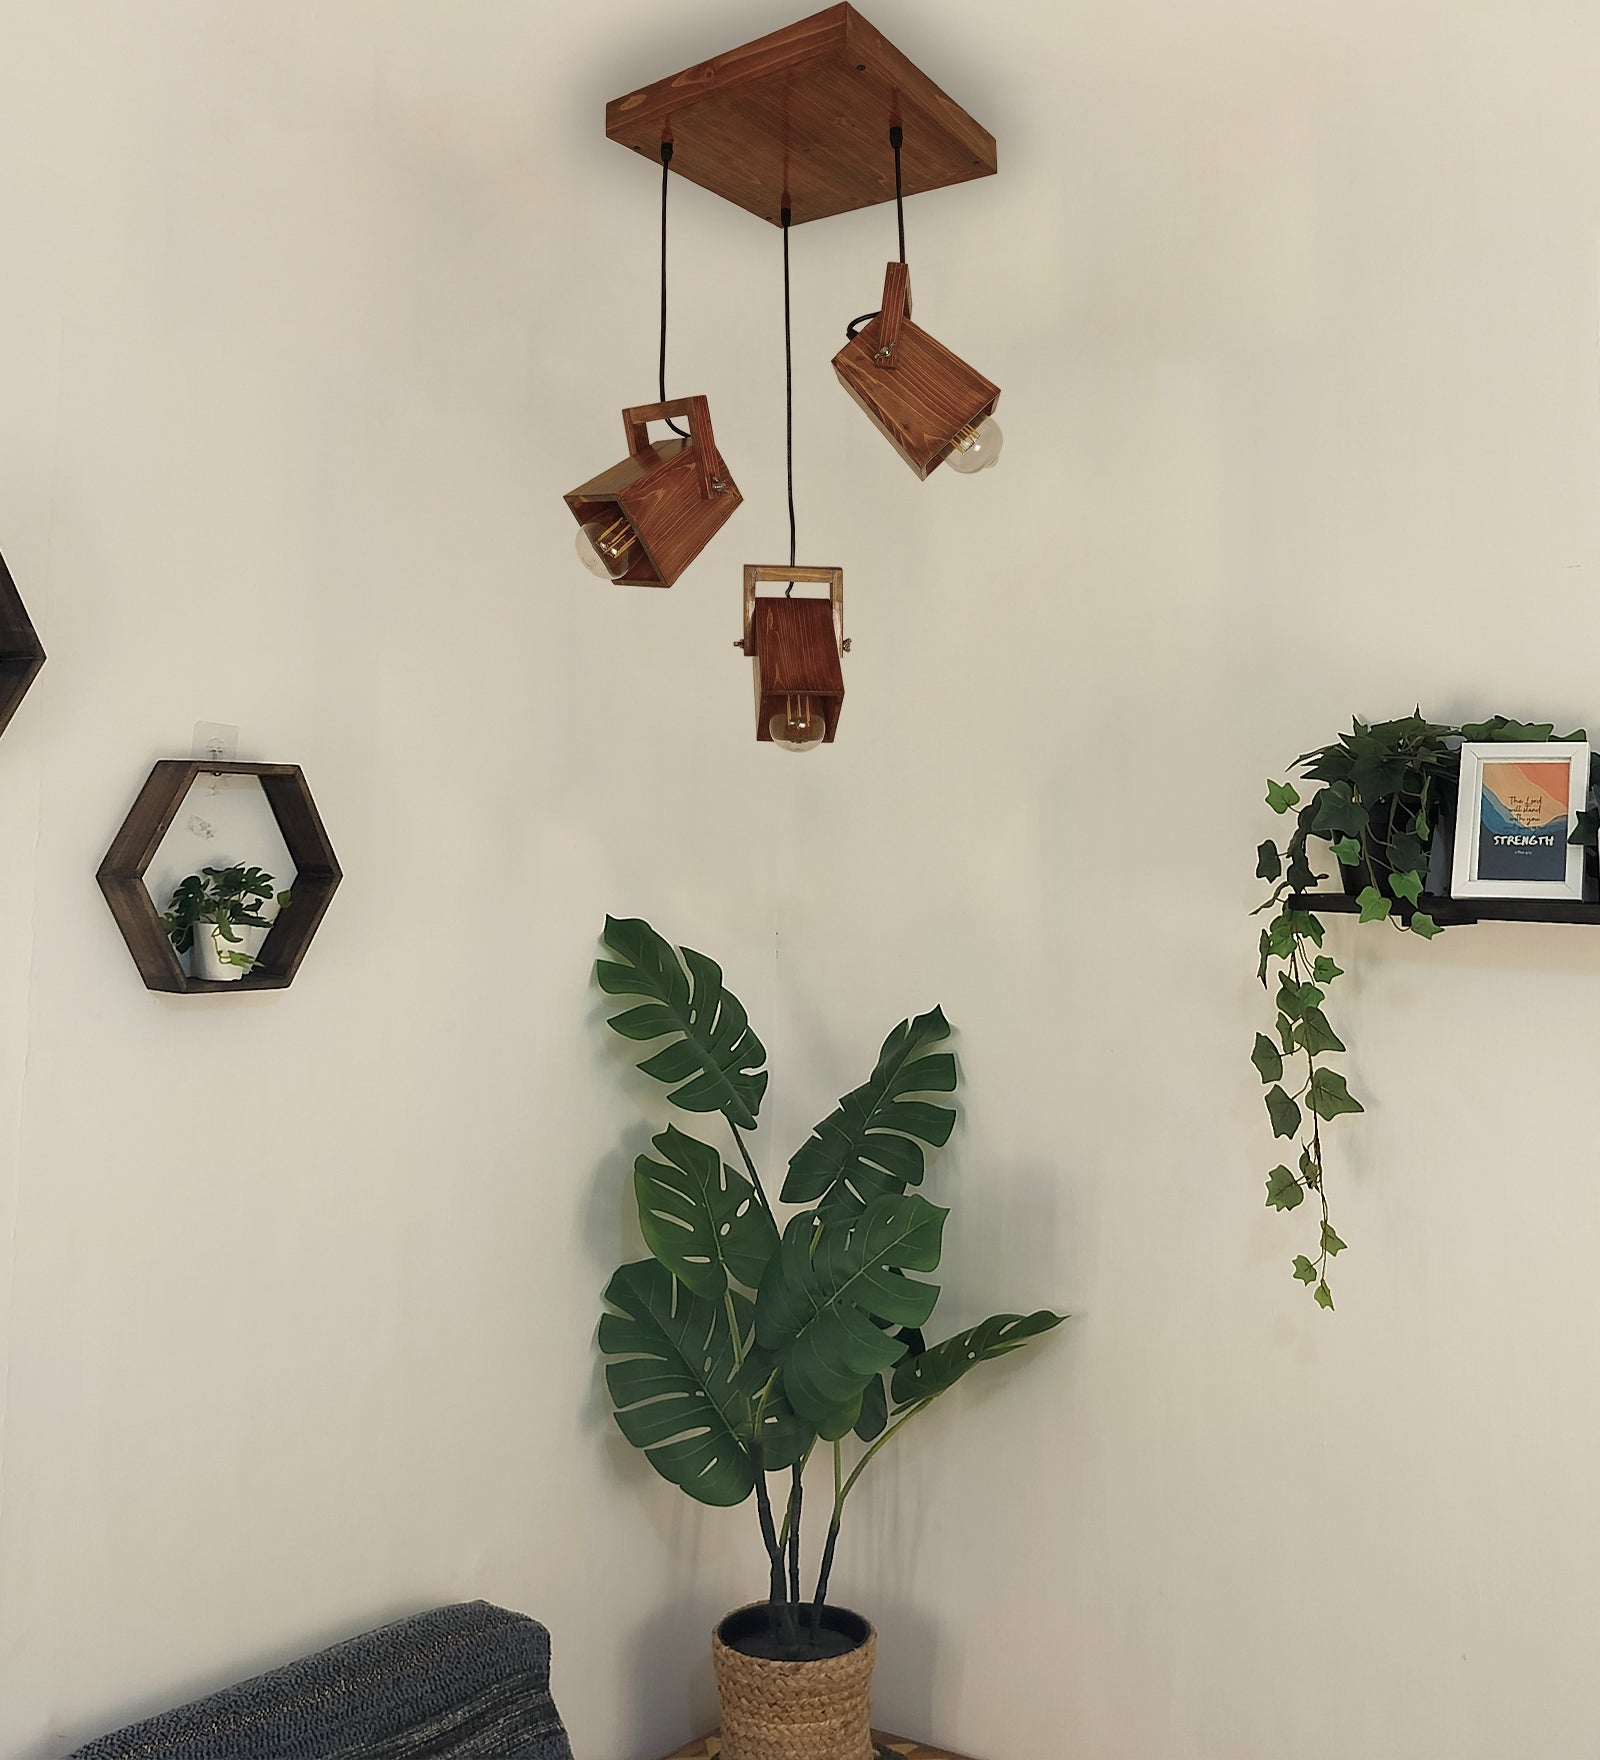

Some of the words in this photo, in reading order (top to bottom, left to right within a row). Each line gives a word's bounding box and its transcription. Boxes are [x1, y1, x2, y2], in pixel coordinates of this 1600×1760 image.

[1508, 796, 1523, 805] The
[1524, 796, 1542, 805] Lord
[1523, 805, 1541, 813] stand
[1509, 813, 1525, 821] with
[1526, 817, 1541, 825] you
[1493, 835, 1554, 846] STRENGTH
